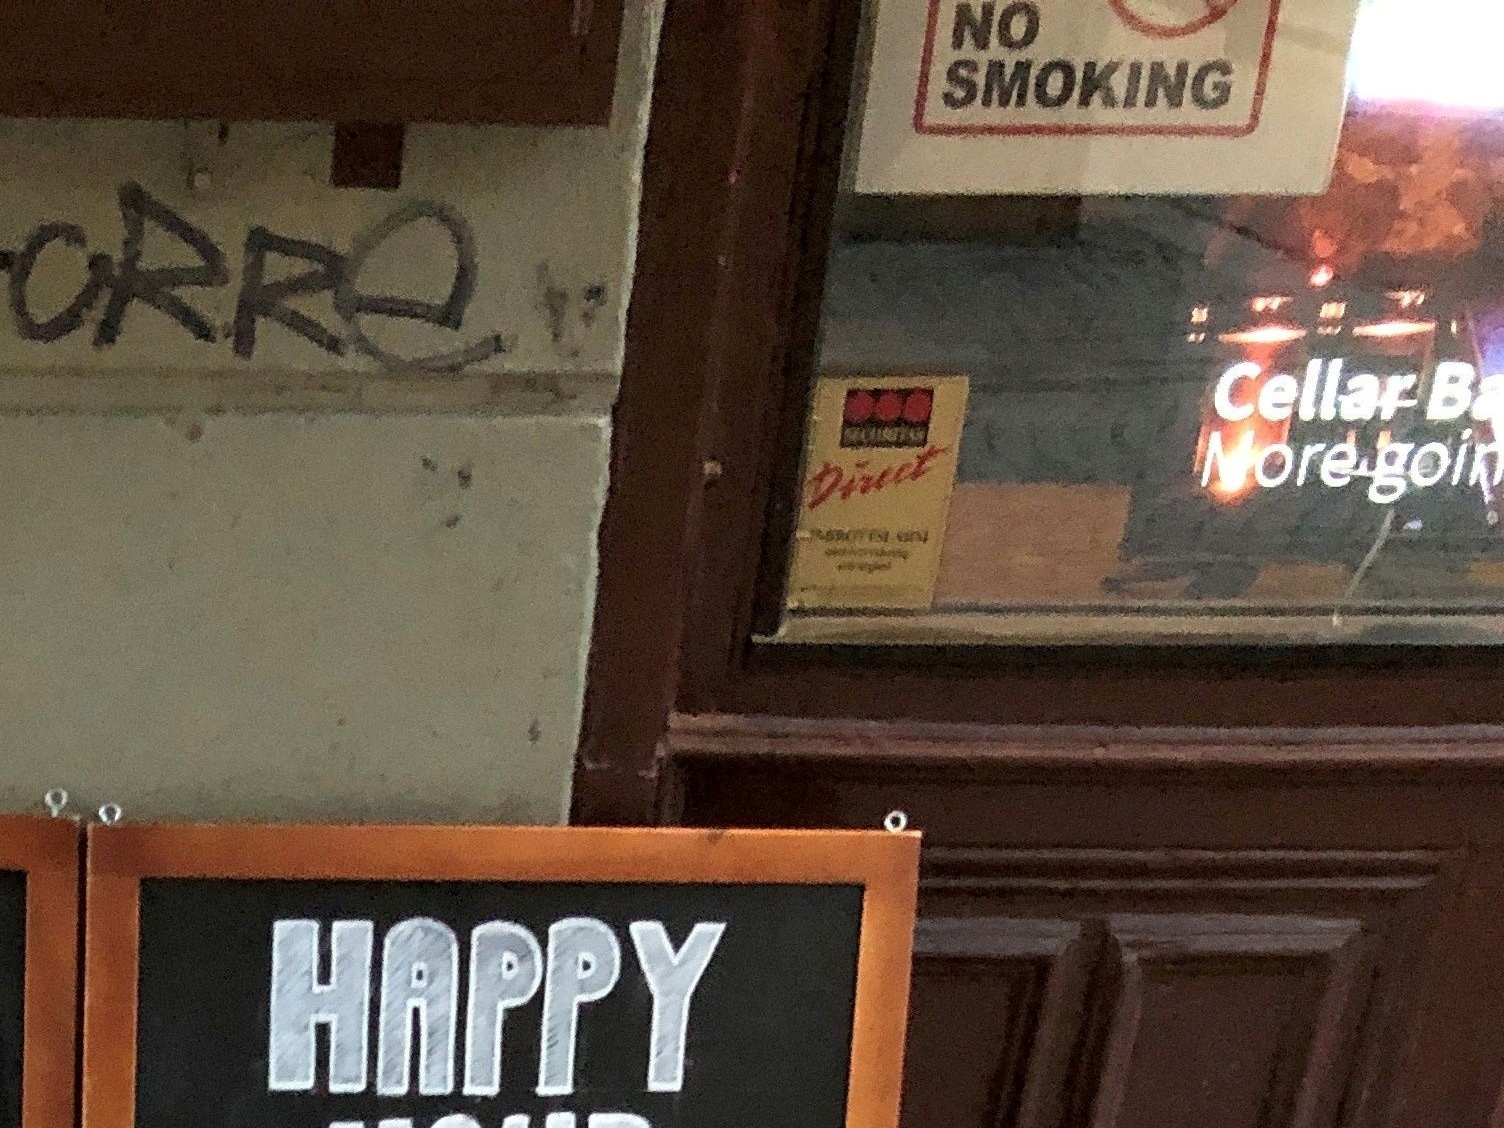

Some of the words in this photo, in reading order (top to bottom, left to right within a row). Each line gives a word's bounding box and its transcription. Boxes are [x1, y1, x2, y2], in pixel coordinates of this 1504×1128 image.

[950, 0, 1040, 51] NO
[942, 57, 1233, 110] SMOKING
[1214, 357, 1418, 422] Cellar
[806, 444, 956, 511] Direct
[1199, 430, 1357, 489] More
[267, 916, 727, 1096] HAPPY
